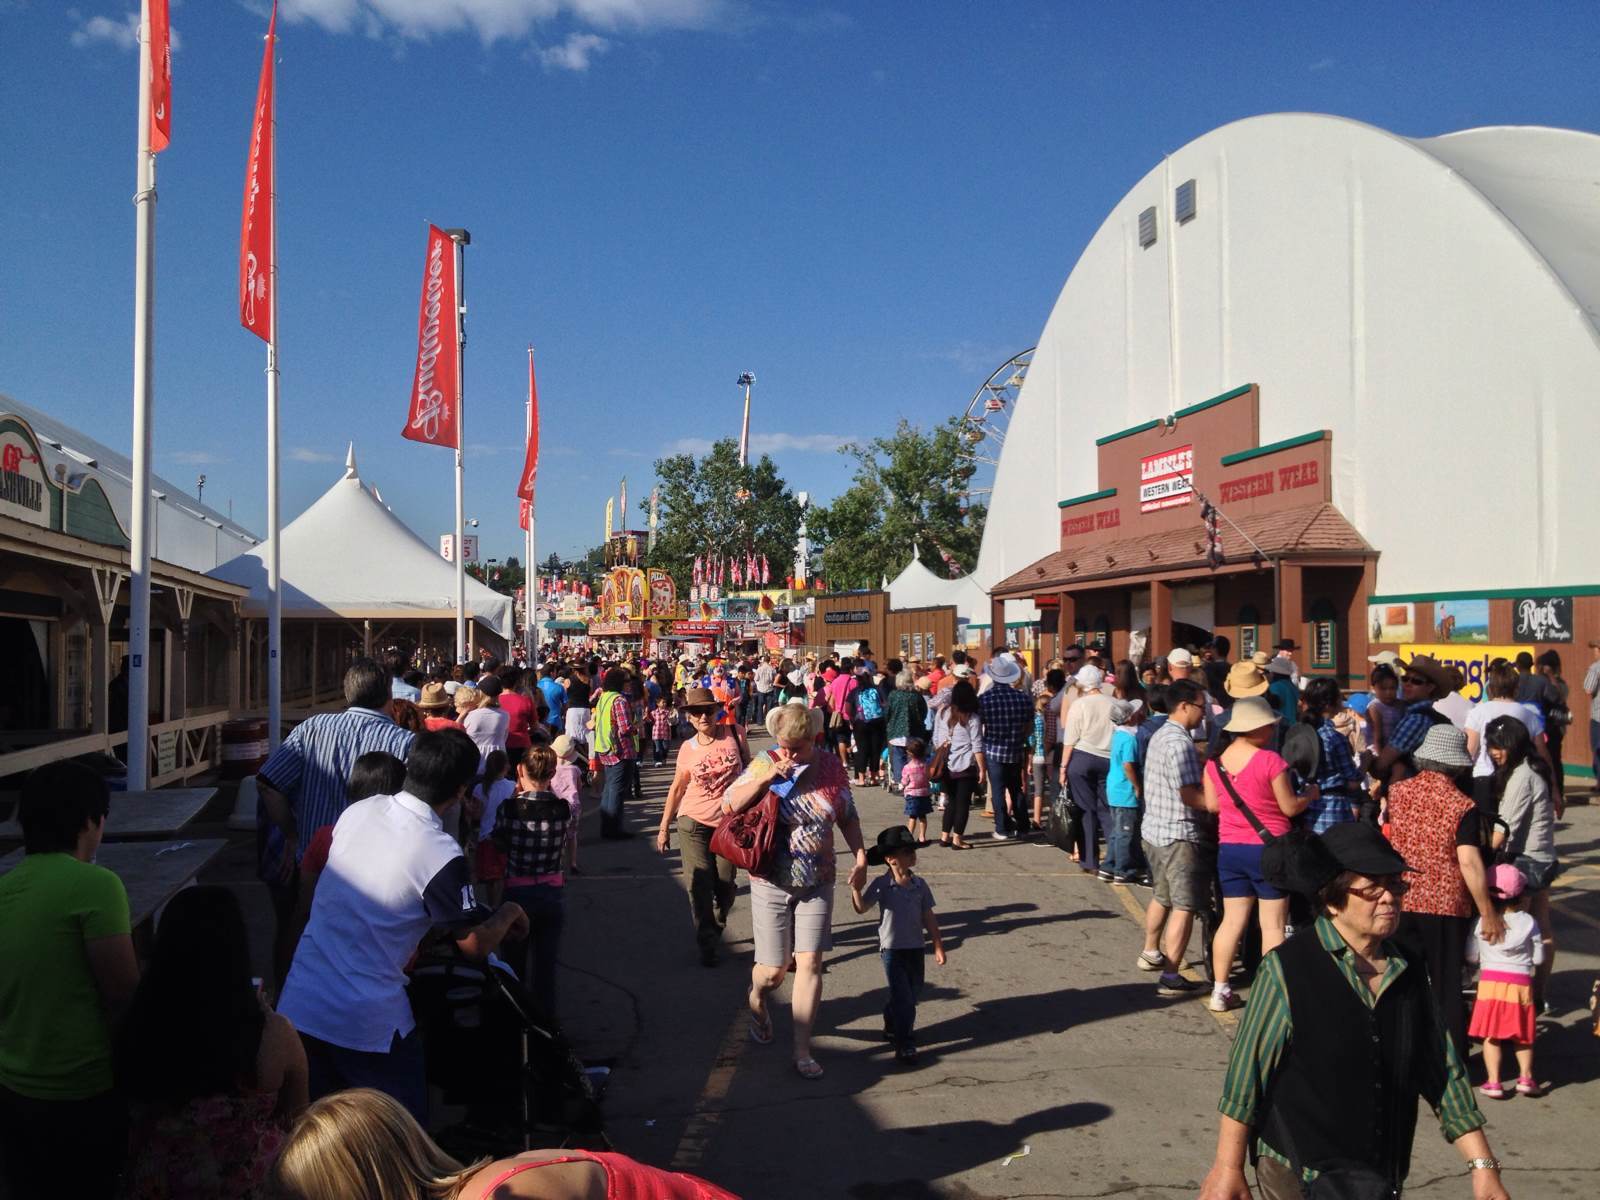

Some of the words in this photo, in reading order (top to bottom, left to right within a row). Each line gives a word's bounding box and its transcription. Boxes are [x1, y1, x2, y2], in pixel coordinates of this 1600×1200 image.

[1143, 482, 1170, 498] WESTERN
[1218, 470, 1274, 505] WESTERN
[1278, 460, 1319, 491] WEAR
[1061, 513, 1095, 537] WESTERN
[1096, 508, 1121, 530] WEAR
[444, 546, 449, 557] 5
[650, 571, 666, 583] PIZZA
[1517, 598, 1564, 635] Rock
